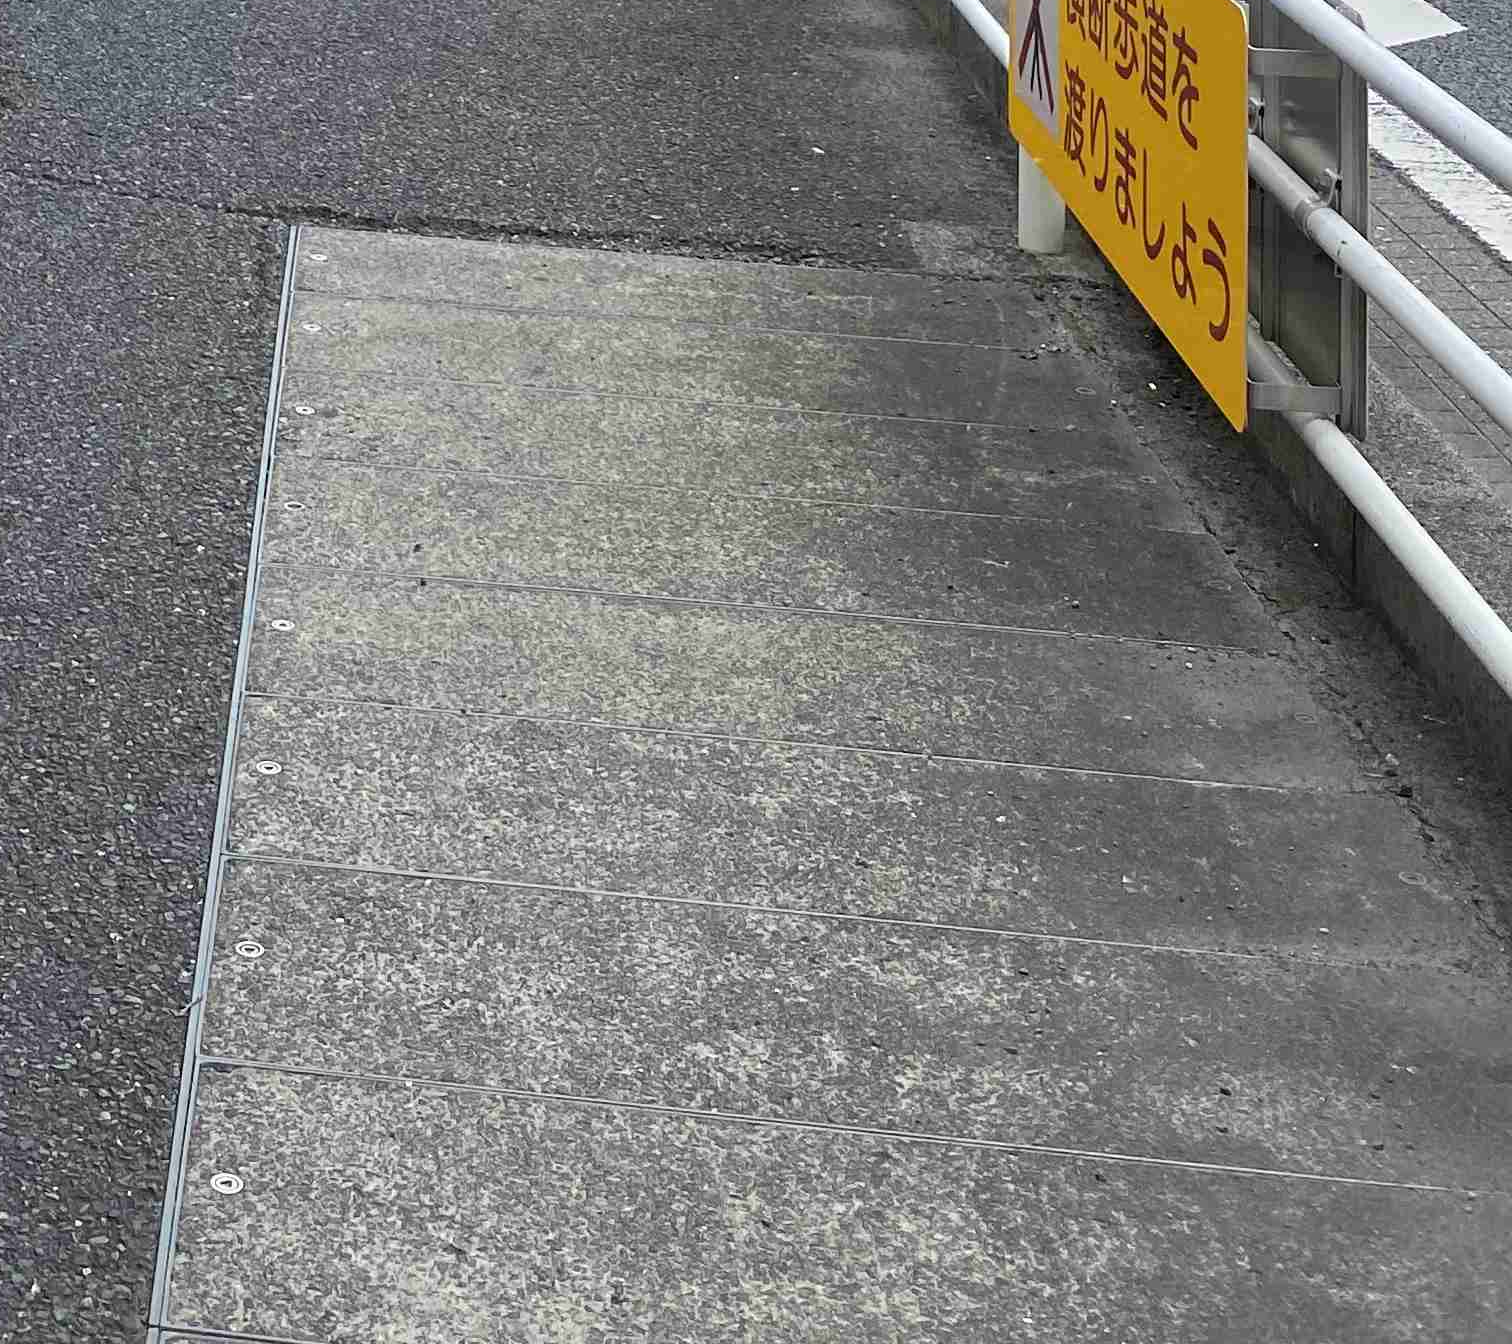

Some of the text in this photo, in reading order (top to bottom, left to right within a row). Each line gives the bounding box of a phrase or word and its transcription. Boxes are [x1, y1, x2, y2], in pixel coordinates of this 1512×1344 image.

[1063, 59, 1232, 342] 渡りましょう
